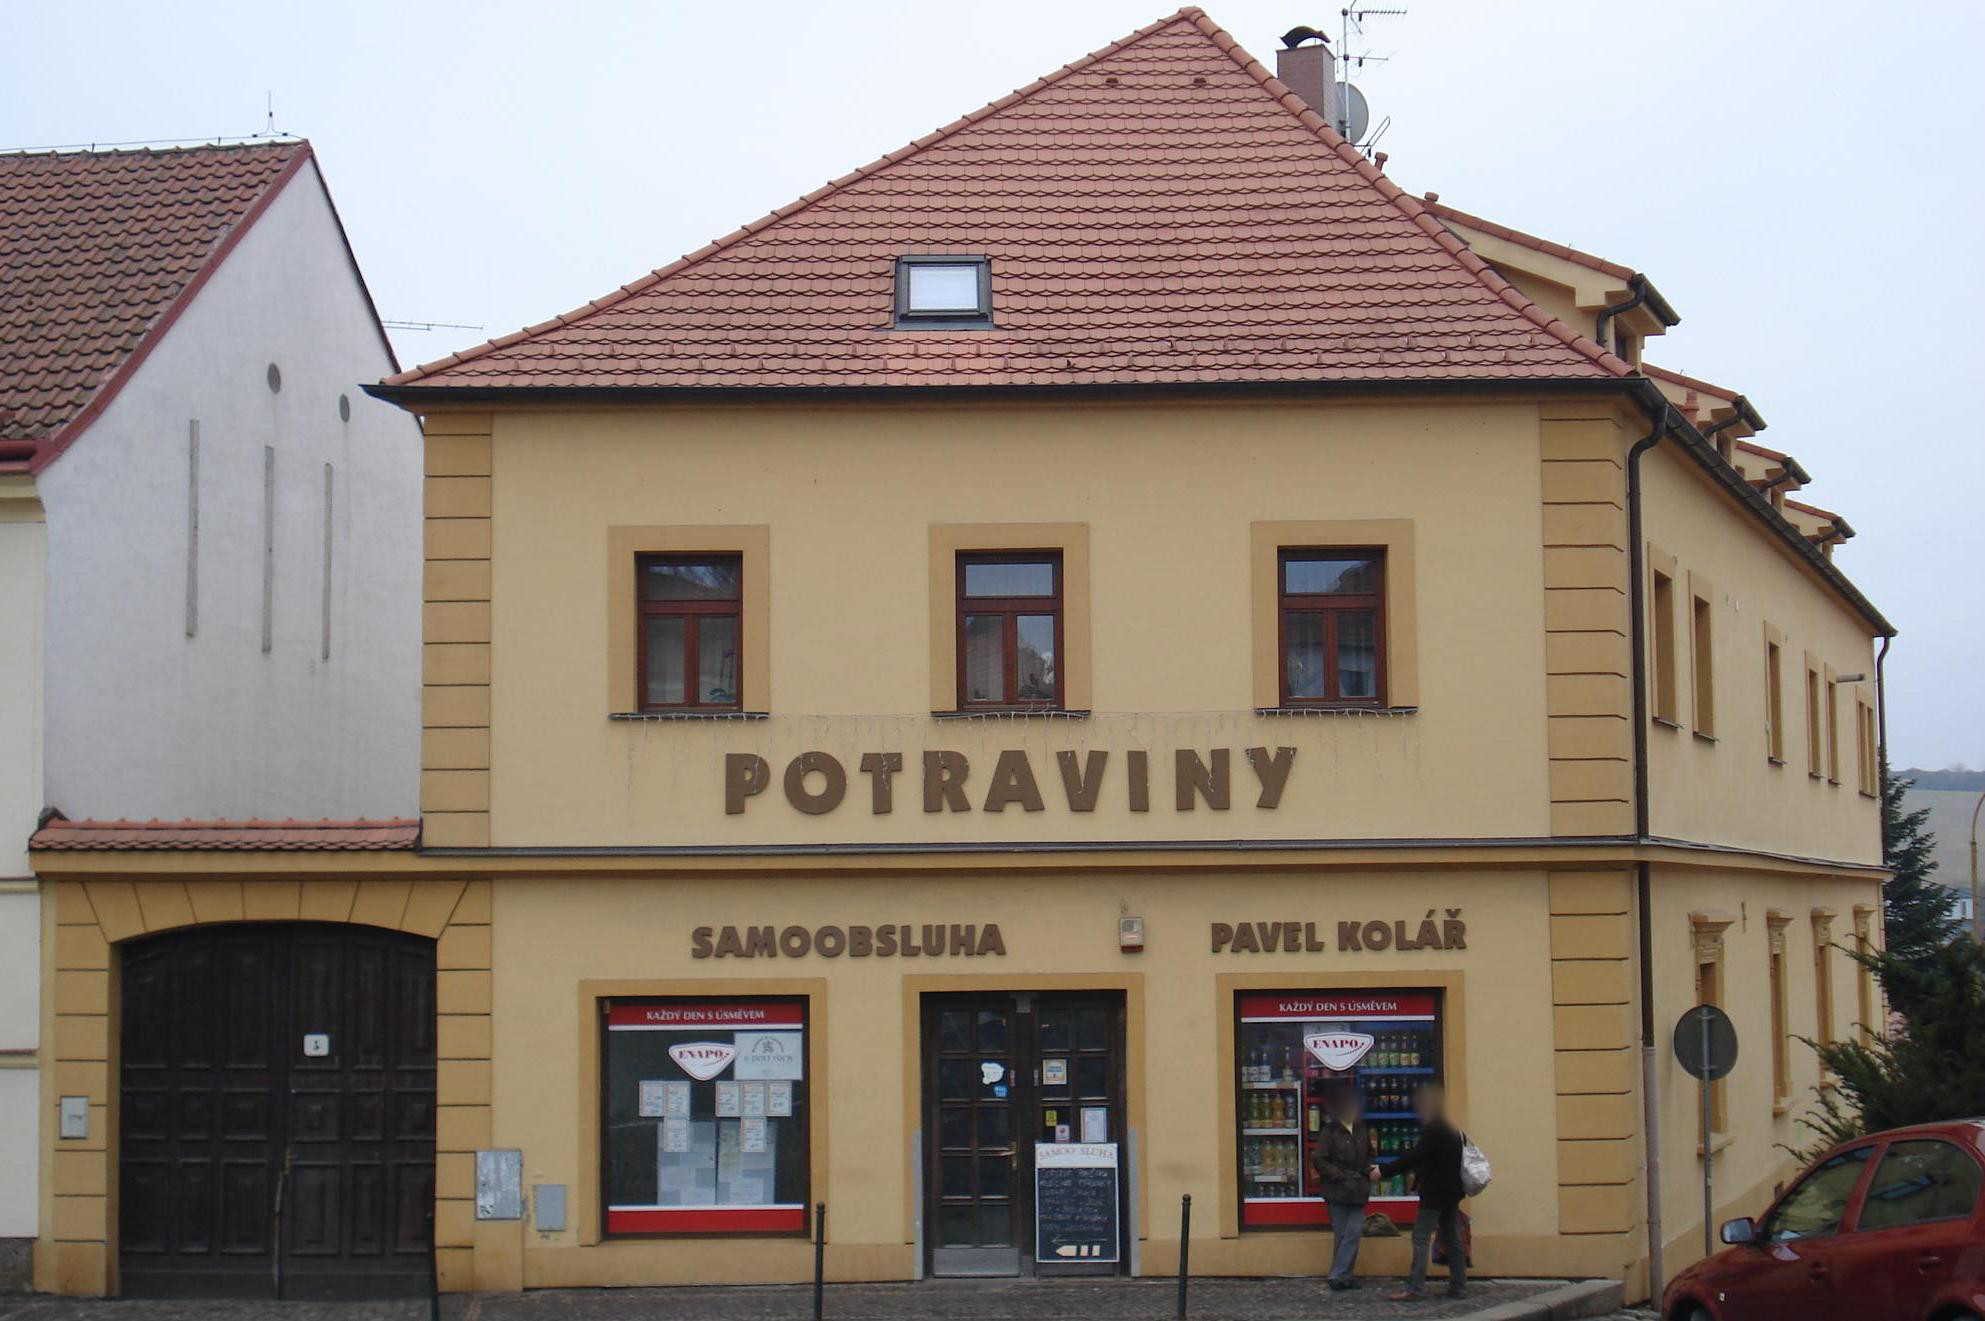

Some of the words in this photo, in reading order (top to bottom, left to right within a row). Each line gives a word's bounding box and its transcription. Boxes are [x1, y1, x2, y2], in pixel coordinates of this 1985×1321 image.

[725, 747, 1298, 815] POTRAVINY
[691, 923, 1007, 958] SAMOOBSLUHA
[1211, 921, 1324, 953] PAVEL
[1337, 908, 1467, 951] KOLÁŘ
[646, 1009, 681, 1021] KAŽDÝ
[683, 1010, 706, 1021] DEN
[708, 1011, 713, 1021] S
[1279, 1001, 1313, 1012] KAŽDÝ
[1316, 1002, 1338, 1011] DEN
[1339, 1002, 1346, 1011] S
[1348, 1000, 1398, 1011] ÚSMĚVEM
[1313, 1039, 1358, 1049] ENAPO
